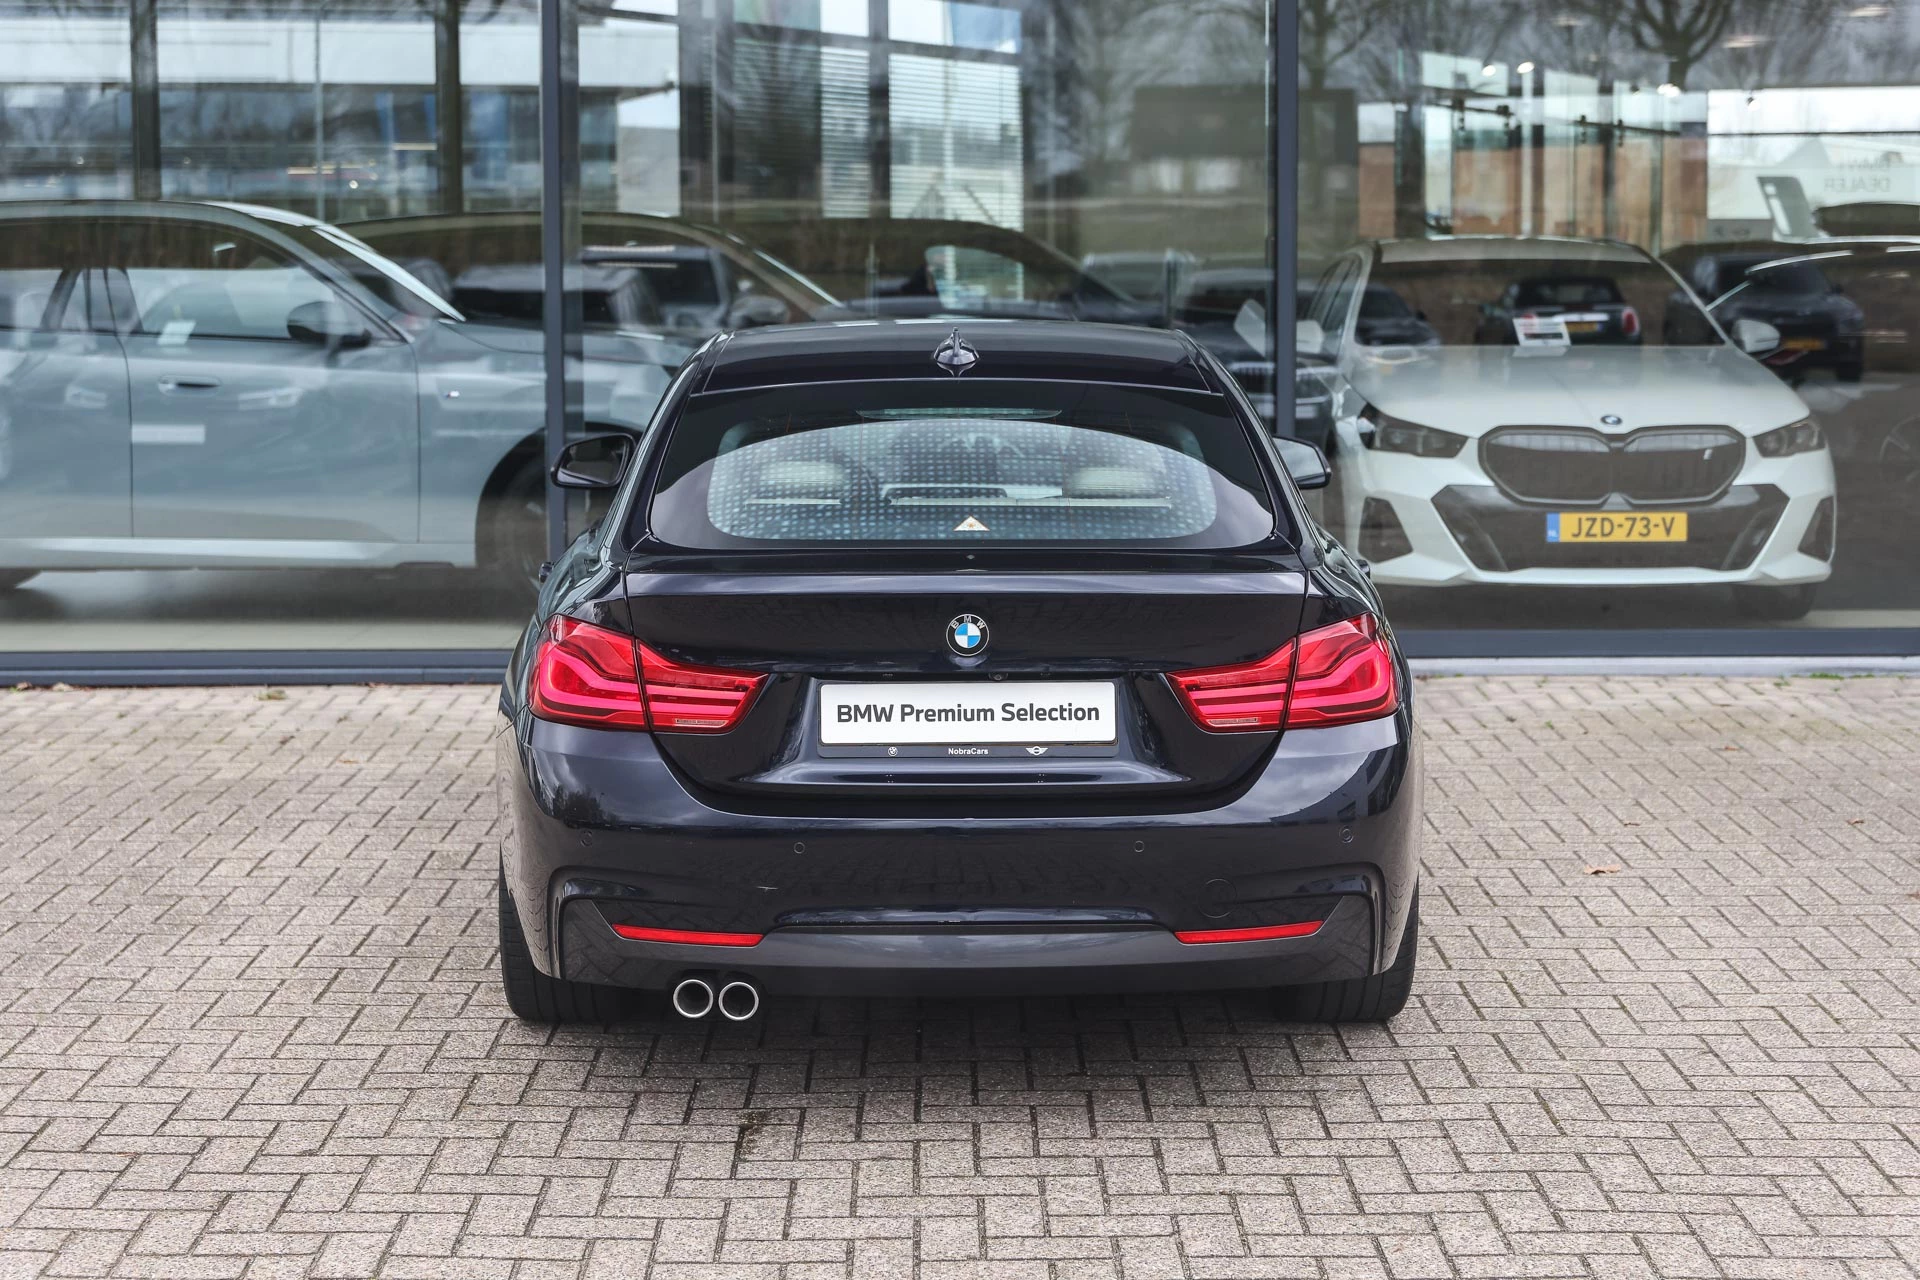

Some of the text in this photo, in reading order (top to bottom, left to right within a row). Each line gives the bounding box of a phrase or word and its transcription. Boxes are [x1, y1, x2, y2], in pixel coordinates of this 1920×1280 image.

[1572, 517, 1674, 537] JZD-73-V
[950, 614, 987, 630] BMW
[838, 703, 1099, 722] BMW Premium Selection
